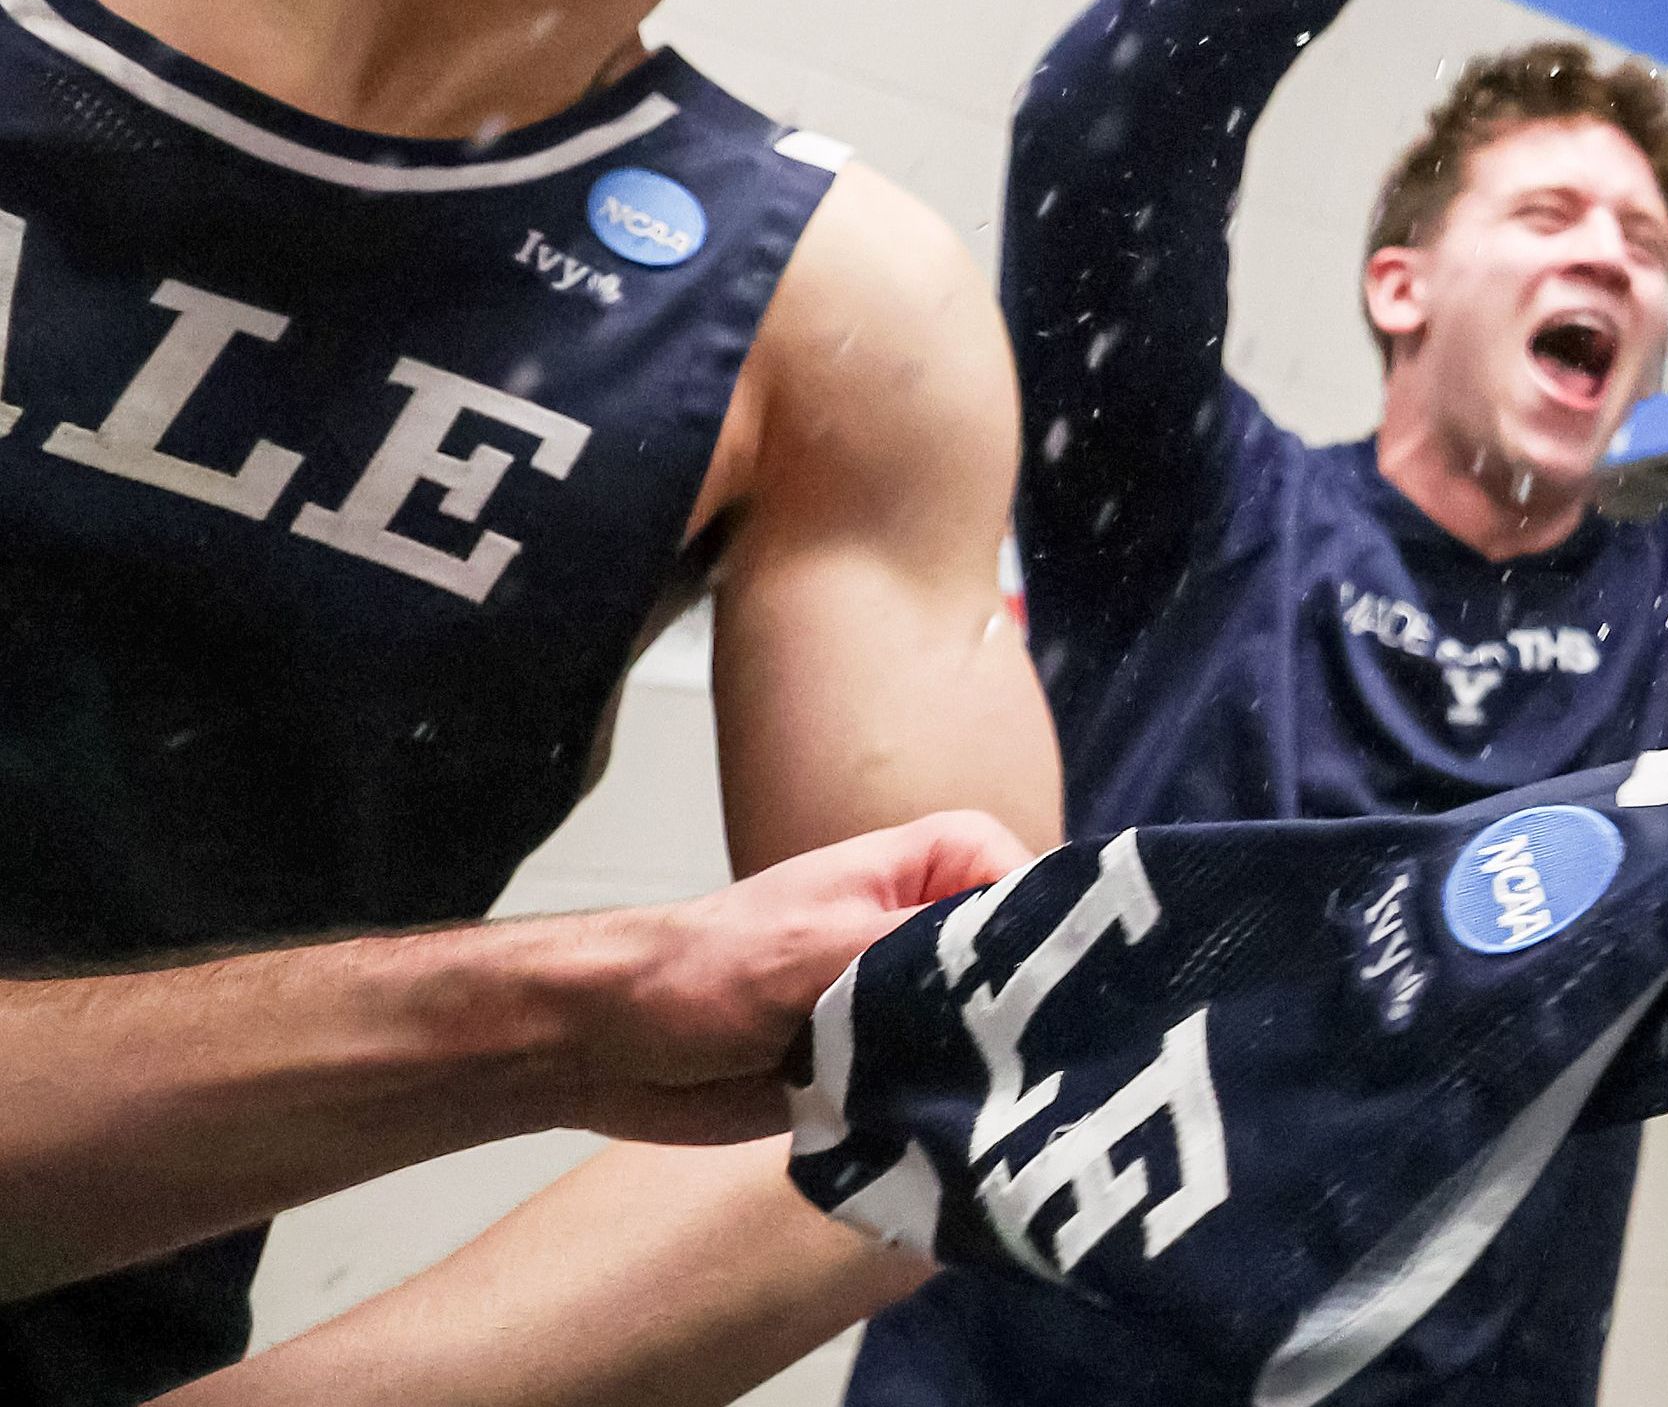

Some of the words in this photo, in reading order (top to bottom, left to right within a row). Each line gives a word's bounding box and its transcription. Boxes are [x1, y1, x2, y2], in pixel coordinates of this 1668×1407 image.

[512, 226, 591, 291] Ivy
[597, 195, 695, 257] NCAA
[0, 206, 593, 605] LE
[1443, 665, 1504, 727] Y
[1358, 873, 1413, 981] Ivy
[1475, 834, 1553, 944] NCAA
